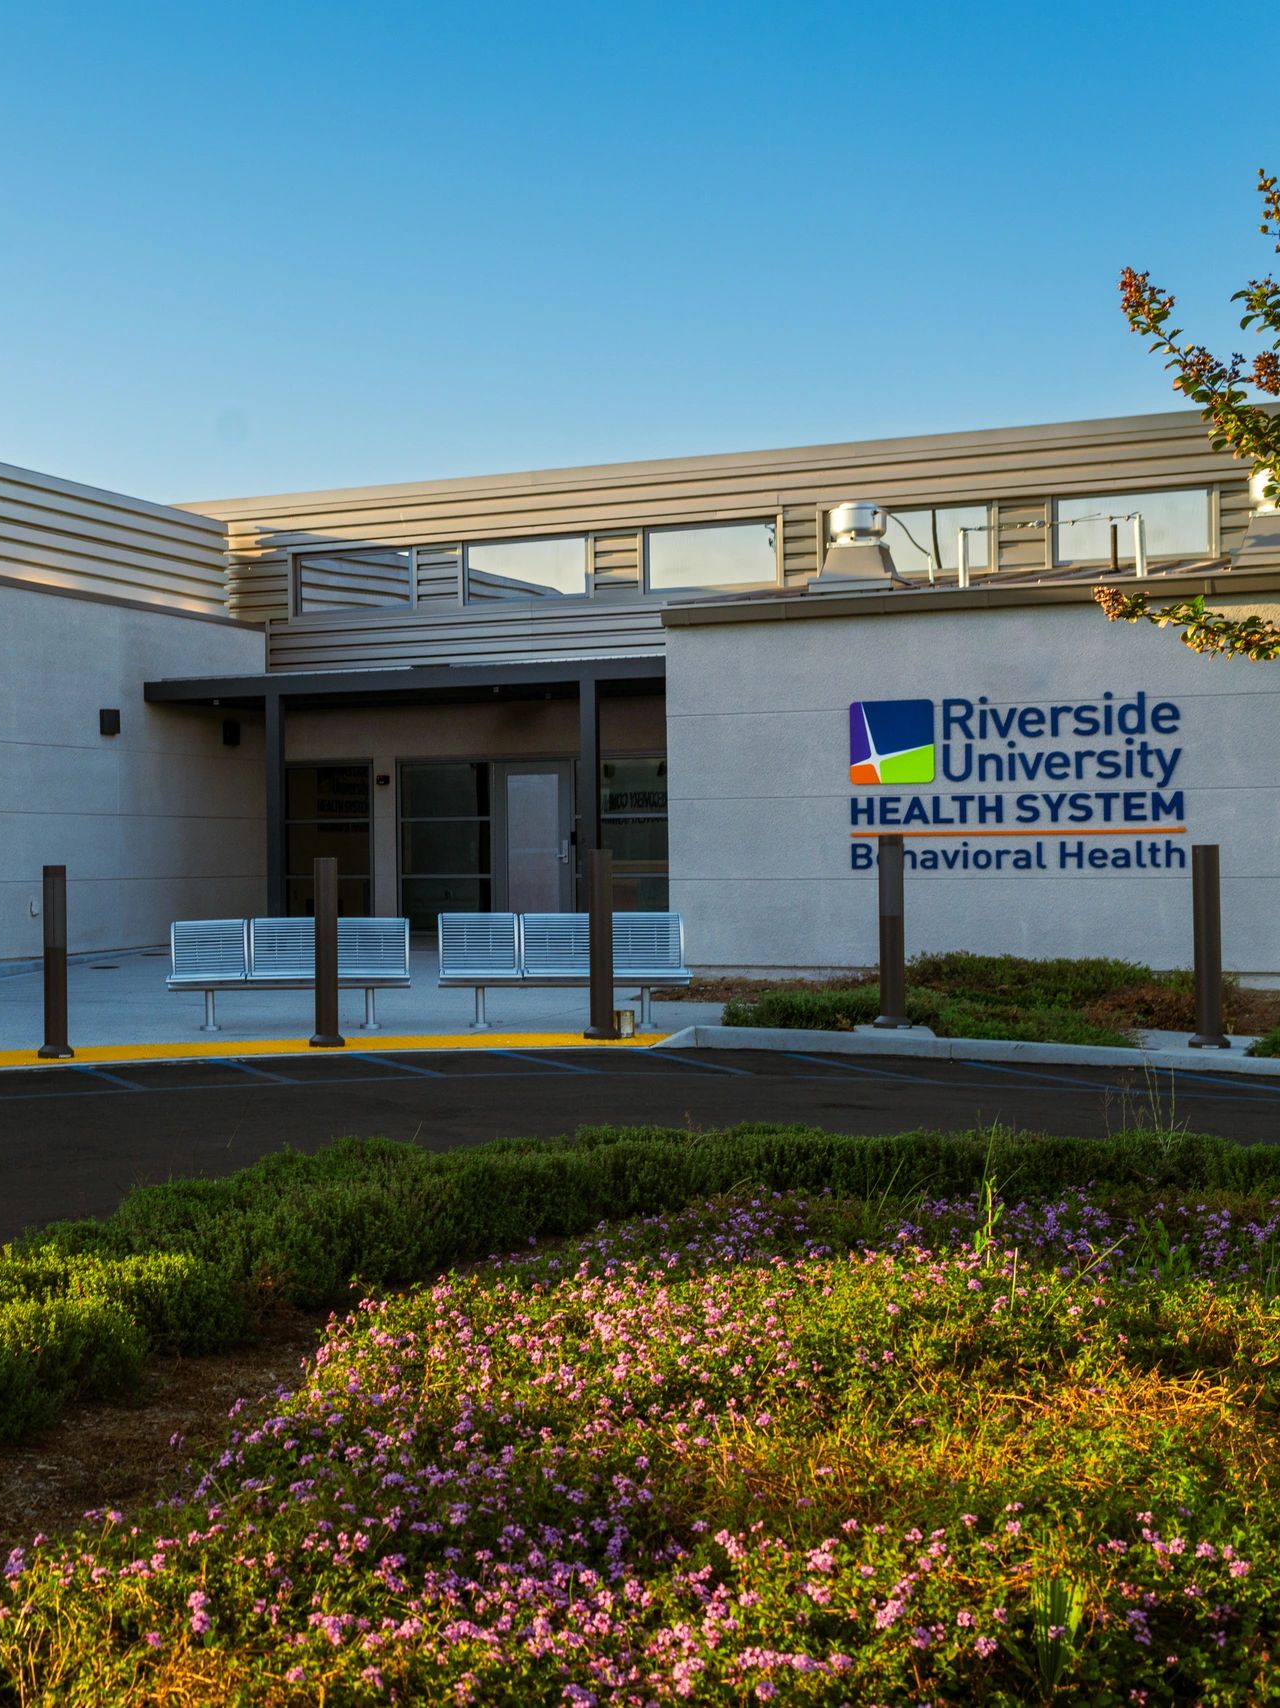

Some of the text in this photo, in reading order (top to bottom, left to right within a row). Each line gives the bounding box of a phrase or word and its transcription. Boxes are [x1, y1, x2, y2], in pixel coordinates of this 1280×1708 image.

[942, 691, 1181, 741] Riverside
[942, 737, 1182, 788] University
[850, 790, 1185, 825] HEALTH SYSTEM
[850, 839, 1186, 870] Bhavioral Health
